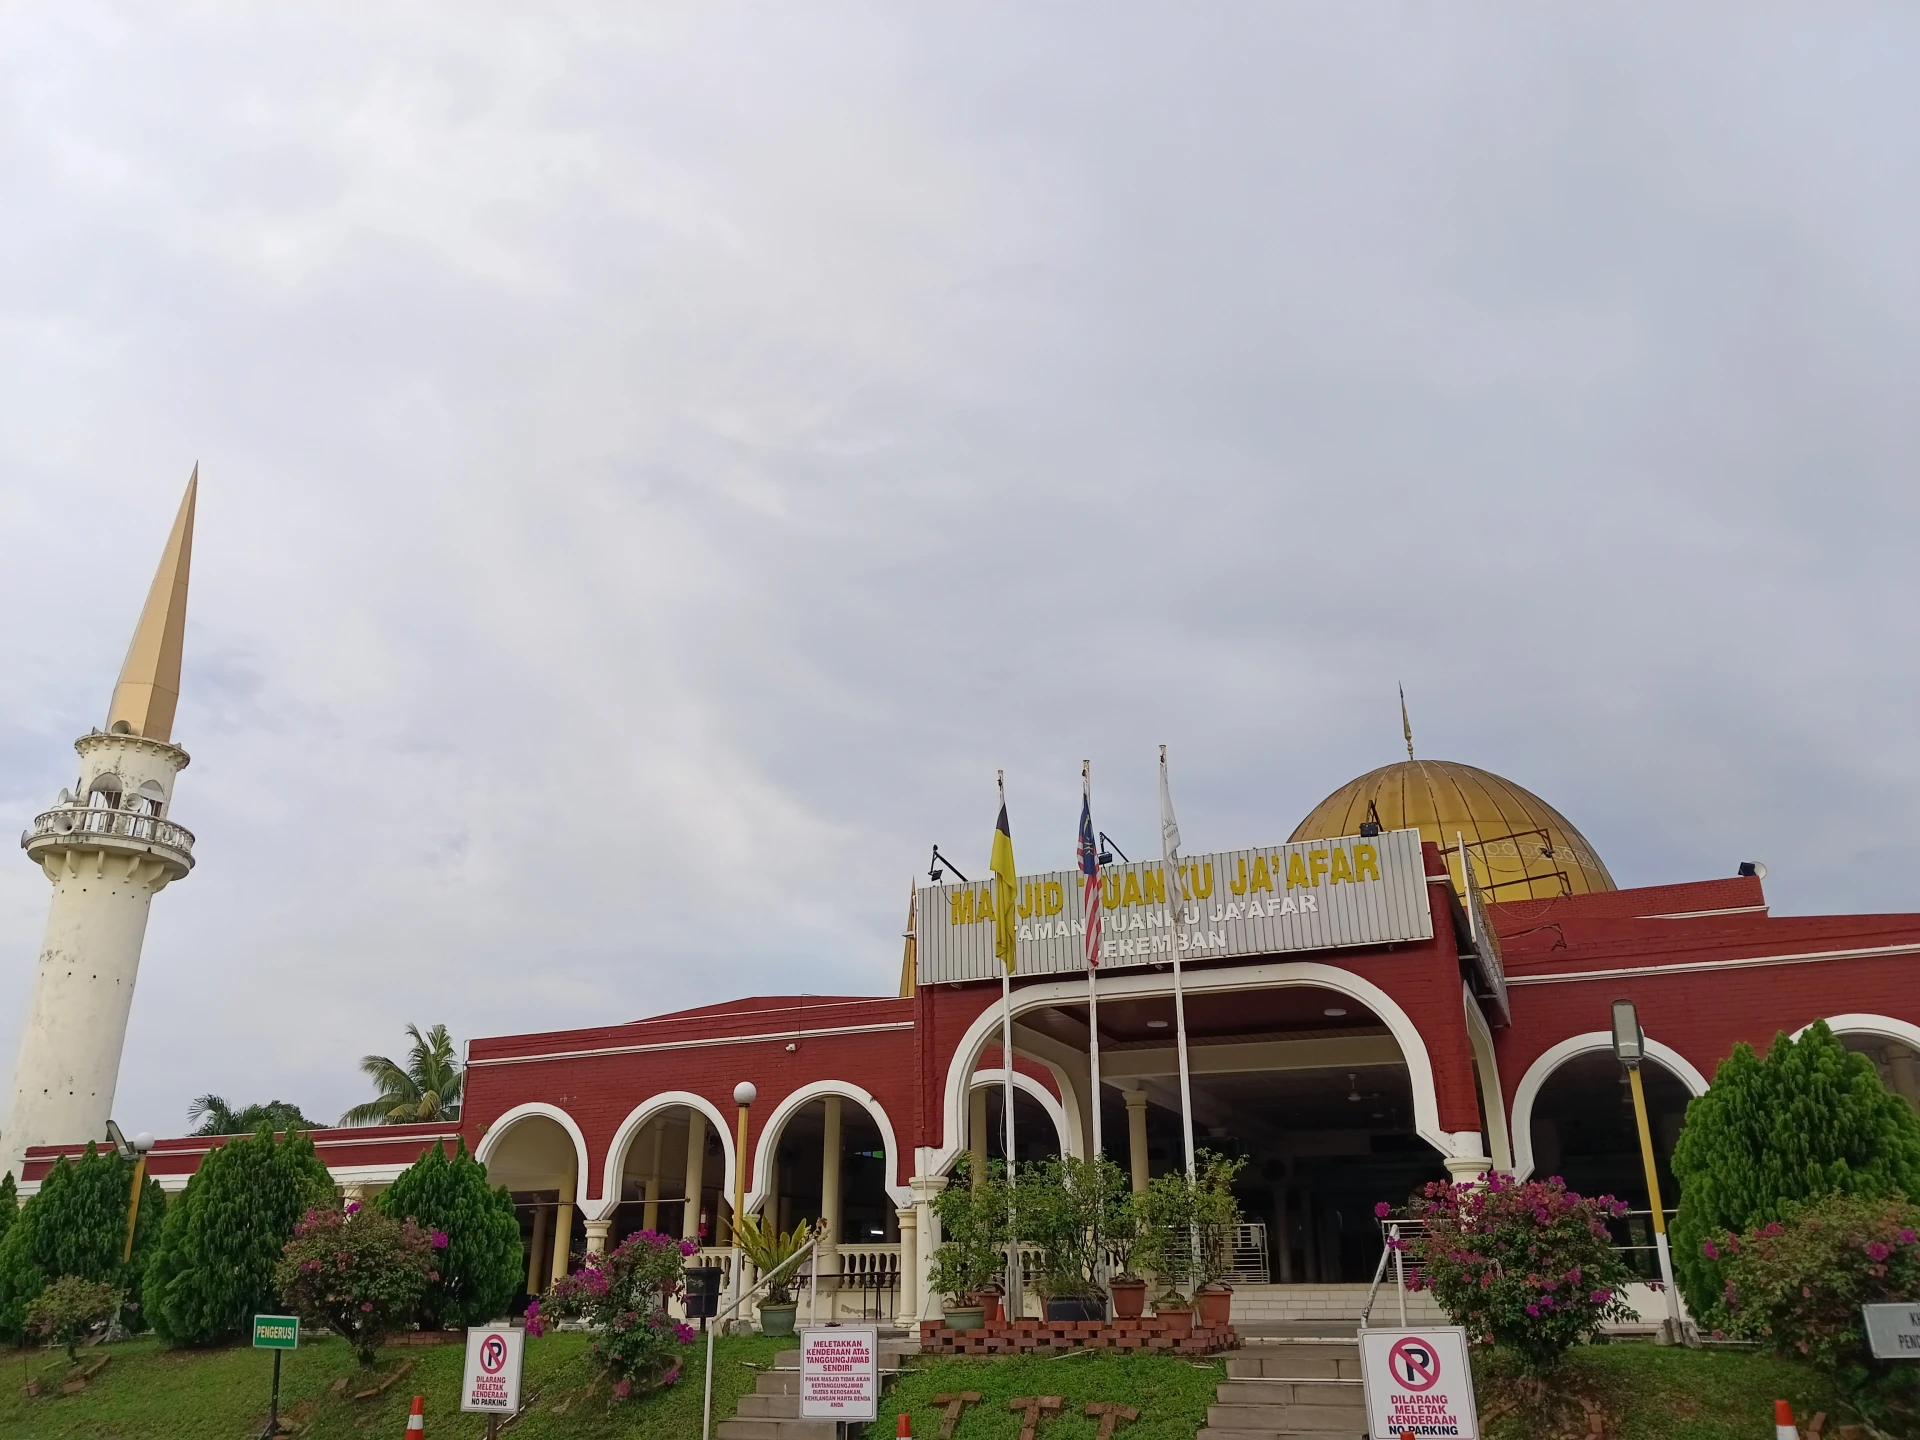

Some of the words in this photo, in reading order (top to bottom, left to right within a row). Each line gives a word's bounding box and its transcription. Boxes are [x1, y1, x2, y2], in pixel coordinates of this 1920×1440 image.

[952, 881, 1064, 925] MAJID
[1078, 863, 1214, 910] UANU
[1230, 844, 1380, 895] JA'AFAR
[1014, 918, 1086, 942] AMAN
[1209, 895, 1319, 922] JA'AFAR
[1098, 930, 1227, 958] EREMBAN
[256, 1325, 295, 1340] PENGERUSI
[813, 1340, 863, 1348] MELETAKKAN
[806, 1348, 851, 1356] KENDERAAN
[852, 1347, 870, 1355] ATAS
[806, 1356, 870, 1364] TANGGUNGJAWAB
[823, 1364, 853, 1372] SENDIRI
[476, 1376, 506, 1384] DILARANG
[476, 1383, 504, 1391] MELETAK
[472, 1390, 509, 1399] KENDERAAN
[471, 1398, 480, 1406] NO
[480, 1398, 507, 1407] PARKING
[1390, 1395, 1448, 1405] DILARANG
[1394, 1405, 1447, 1414] MELETAK
[1387, 1415, 1457, 1425] KENDERAAN
[1389, 1425, 1405, 1436] NO
[1408, 1425, 1459, 1436] PARKING
